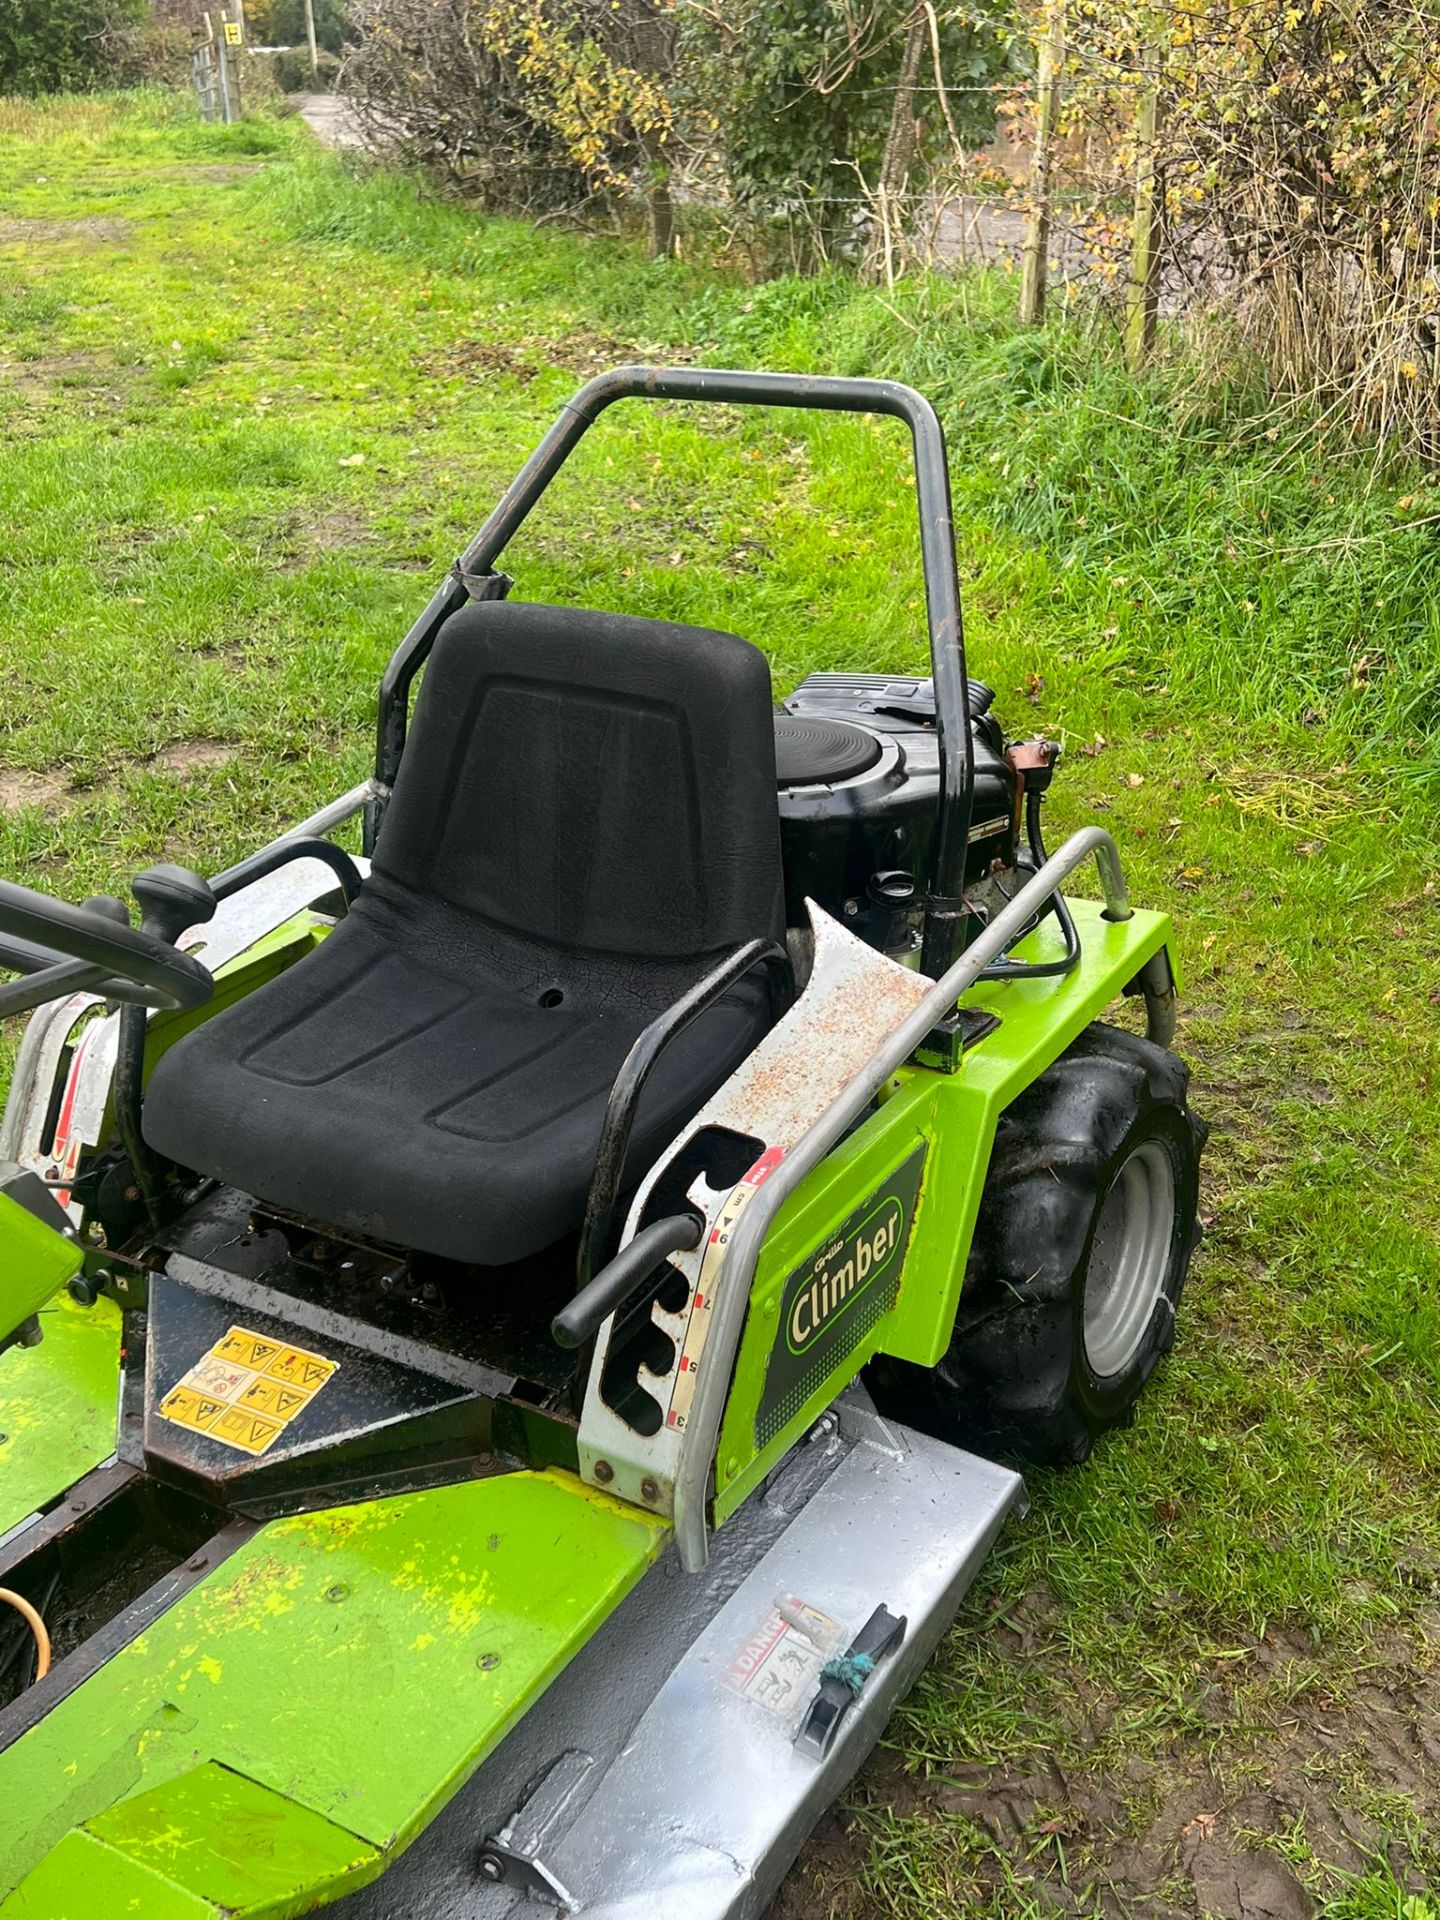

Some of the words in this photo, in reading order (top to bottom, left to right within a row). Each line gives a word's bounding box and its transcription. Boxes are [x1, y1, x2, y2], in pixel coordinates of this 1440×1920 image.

[751, 1167, 768, 1184] STOP
[733, 1193, 746, 1206] cm
[719, 1233, 728, 1245] 9
[814, 1239, 844, 1273] Grillo
[792, 1211, 898, 1343] Climber
[703, 1299, 711, 1311] 7
[689, 1361, 698, 1373] 5
[677, 1415, 686, 1427] 3
